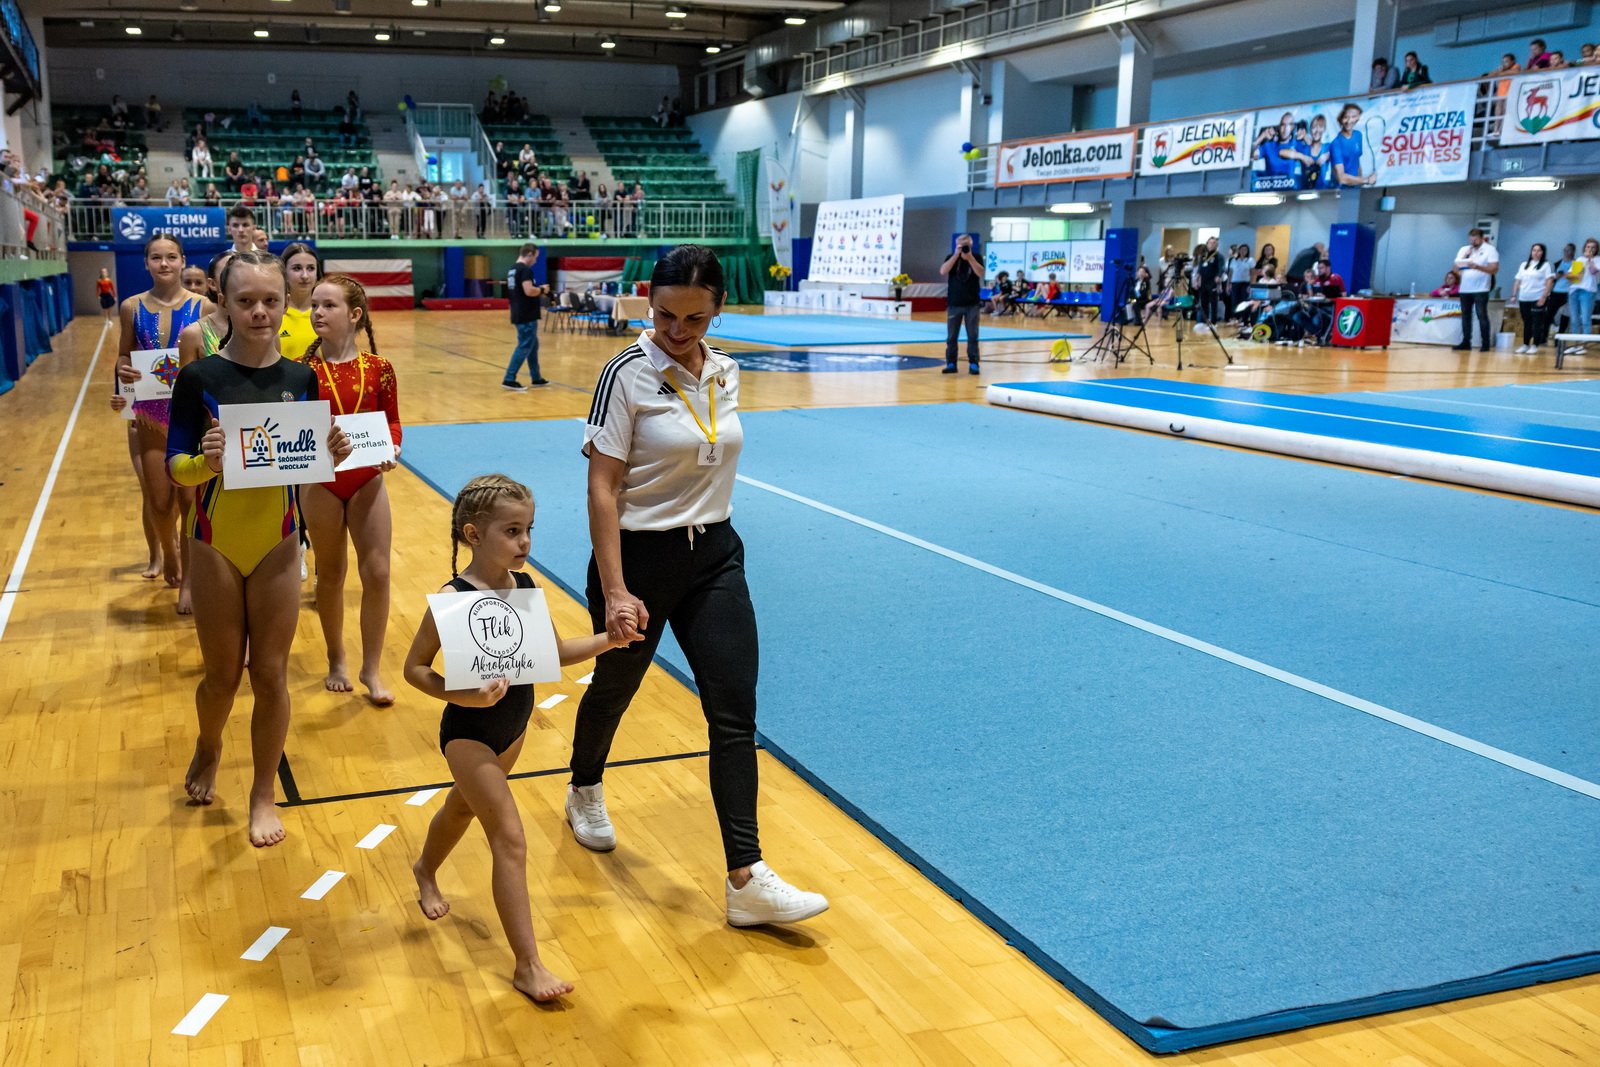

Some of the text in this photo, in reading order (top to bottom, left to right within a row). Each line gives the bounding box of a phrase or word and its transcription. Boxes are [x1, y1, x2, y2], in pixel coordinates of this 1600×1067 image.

[1568, 75, 1600, 99] JE
[1177, 120, 1236, 143] JELENIA
[1398, 110, 1466, 133] STREFA
[1381, 128, 1465, 153] SQUASH
[1023, 142, 1123, 168] Jelonka.com
[1191, 143, 1235, 166] GÓRA
[1386, 147, 1462, 167] & FITNESS
[164, 213, 207, 225] TERMY
[152, 226, 220, 238] CIEPLICKIE
[1041, 250, 1066, 261] JELENIA
[277, 429, 317, 453] mdk
[345, 430, 370, 440] Piast
[352, 440, 387, 450] croflash
[278, 454, 316, 463] ŚRÓDMIEŚCIE
[473, 600, 513, 616] KLUB SPORTOWY
[476, 615, 515, 641] Flik
[470, 653, 536, 679] Akrobatyka
